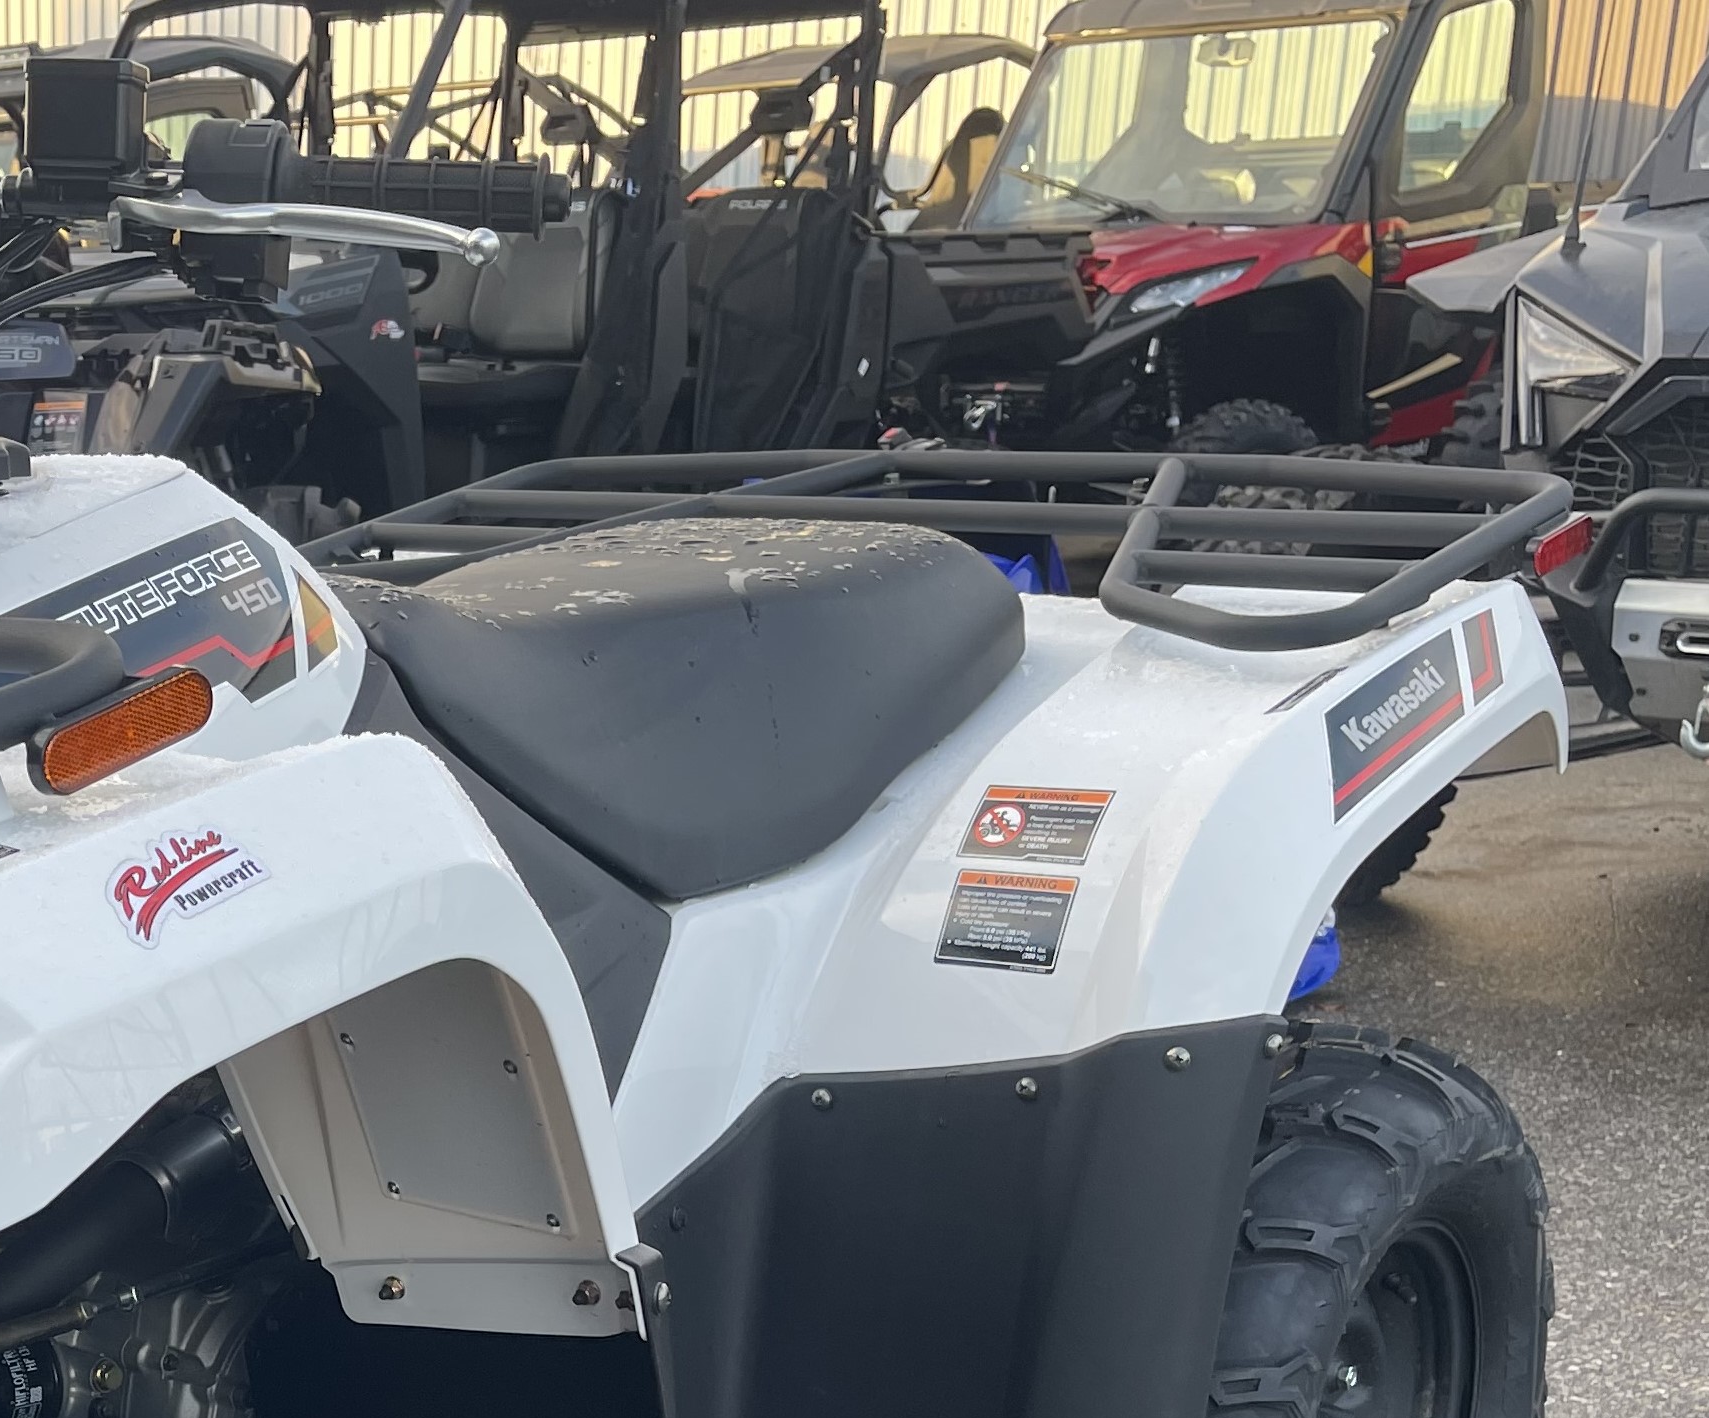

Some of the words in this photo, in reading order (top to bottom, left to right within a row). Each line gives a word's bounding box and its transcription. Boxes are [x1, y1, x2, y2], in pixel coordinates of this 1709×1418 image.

[728, 199, 788, 210] POLARS
[297, 281, 364, 306] 1000
[150, 539, 262, 608] FORCE
[220, 576, 284, 617] 450
[1339, 657, 1446, 753] Kawasaki
[1029, 792, 1080, 801] WARNING
[173, 859, 263, 911] Powercraft
[994, 875, 1058, 890] WARNING
